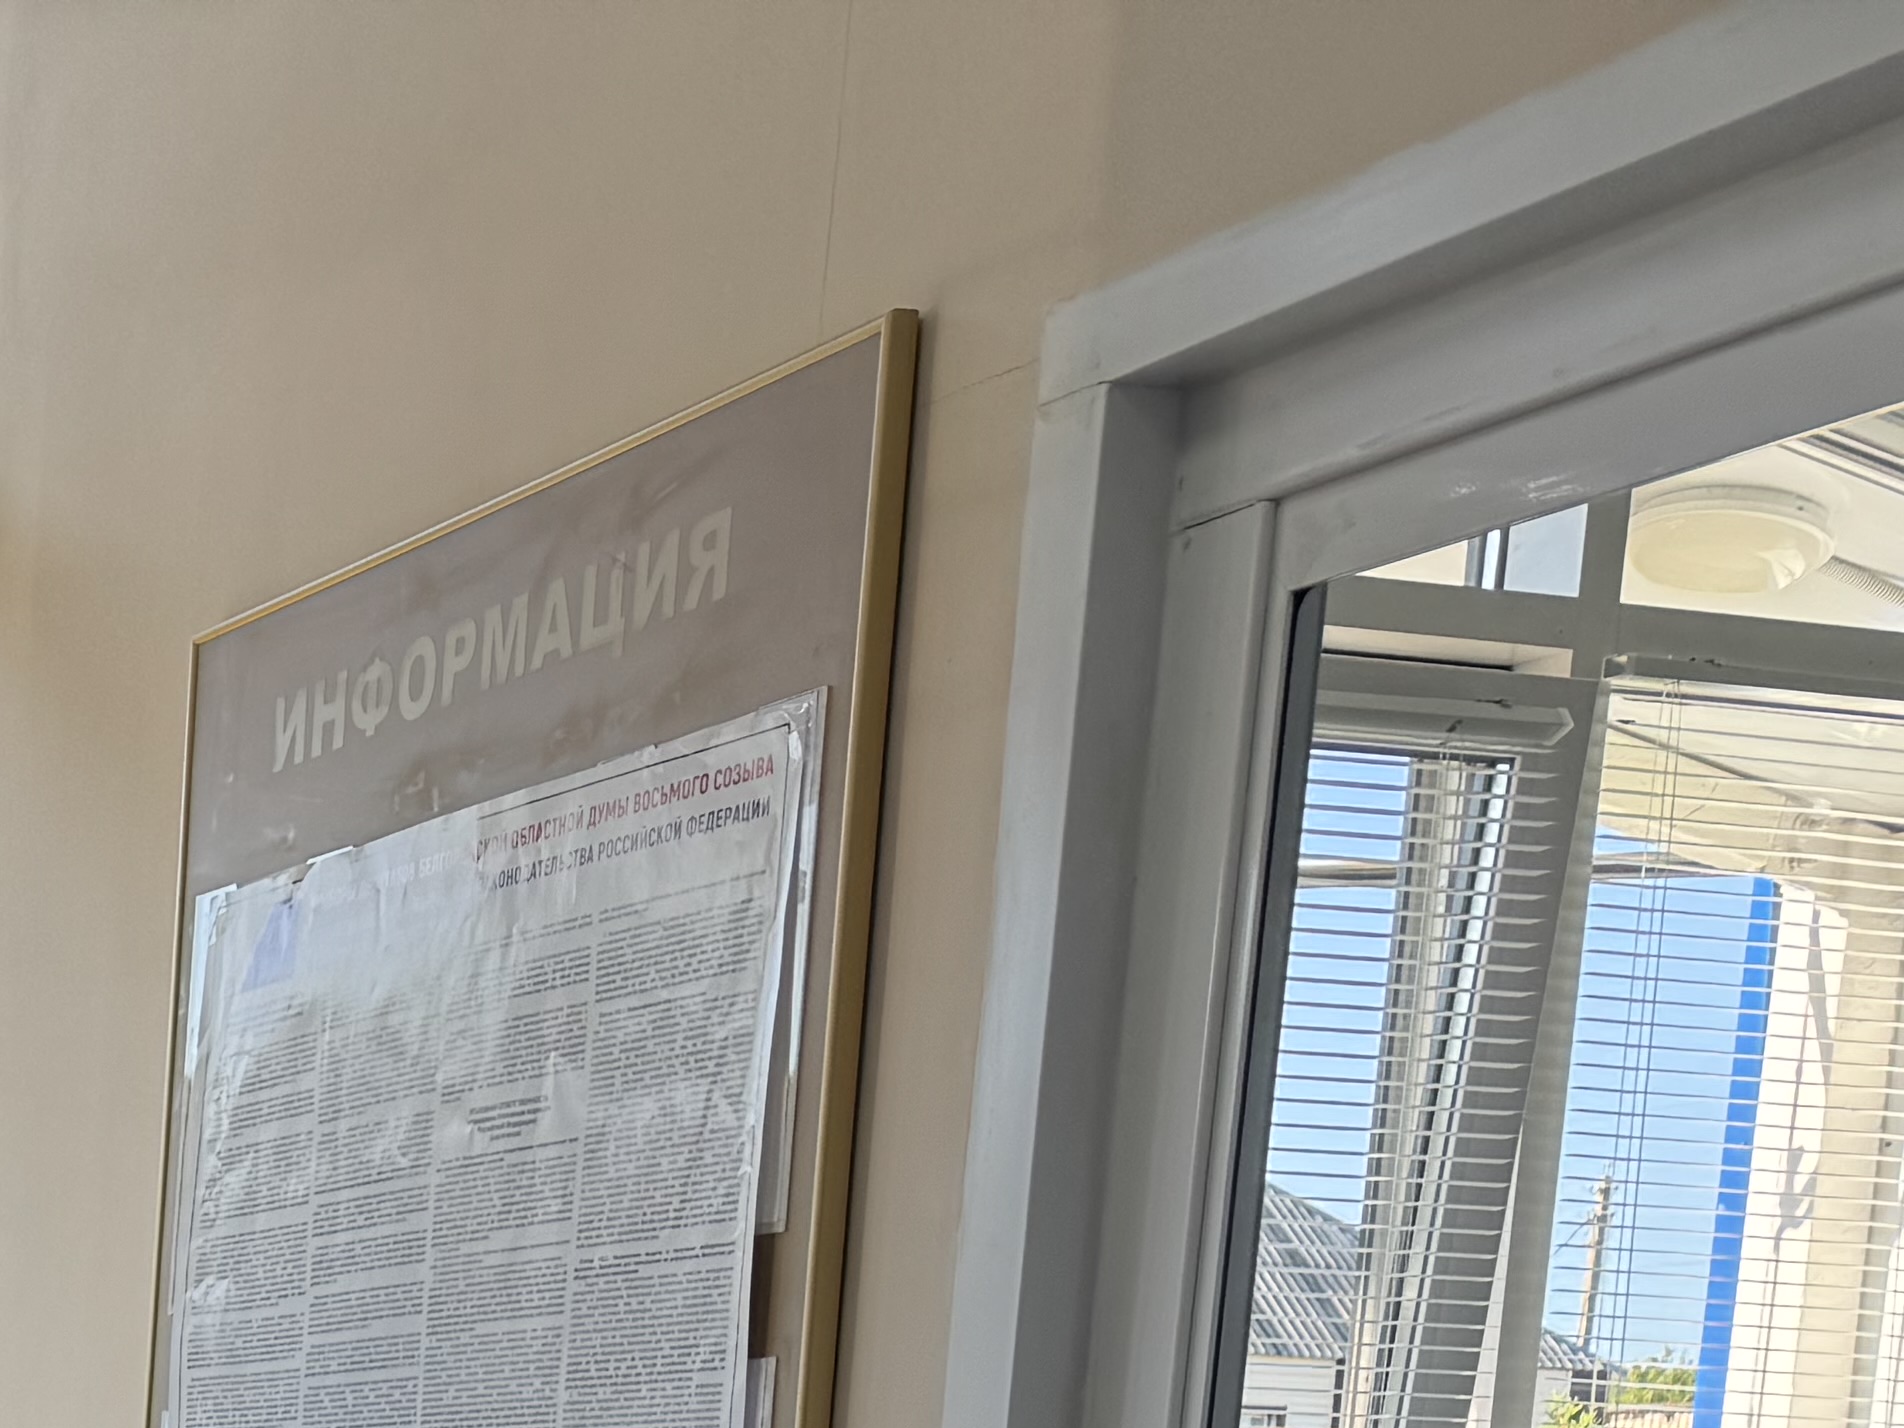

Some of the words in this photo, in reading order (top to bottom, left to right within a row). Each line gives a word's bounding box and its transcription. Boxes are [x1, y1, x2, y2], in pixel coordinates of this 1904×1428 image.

[272, 506, 733, 772] ИНФОРМАЦИЯ
[511, 805, 584, 850] ОБЛАСТНОЙ
[587, 796, 630, 830] ДУМЫ
[633, 773, 710, 814] ВОСЬМОГО
[713, 754, 775, 791] СОЗЫВА
[597, 815, 683, 862] РОССИЙСКОЙ
[686, 795, 771, 837] ФЕДЕРАЦИИ
